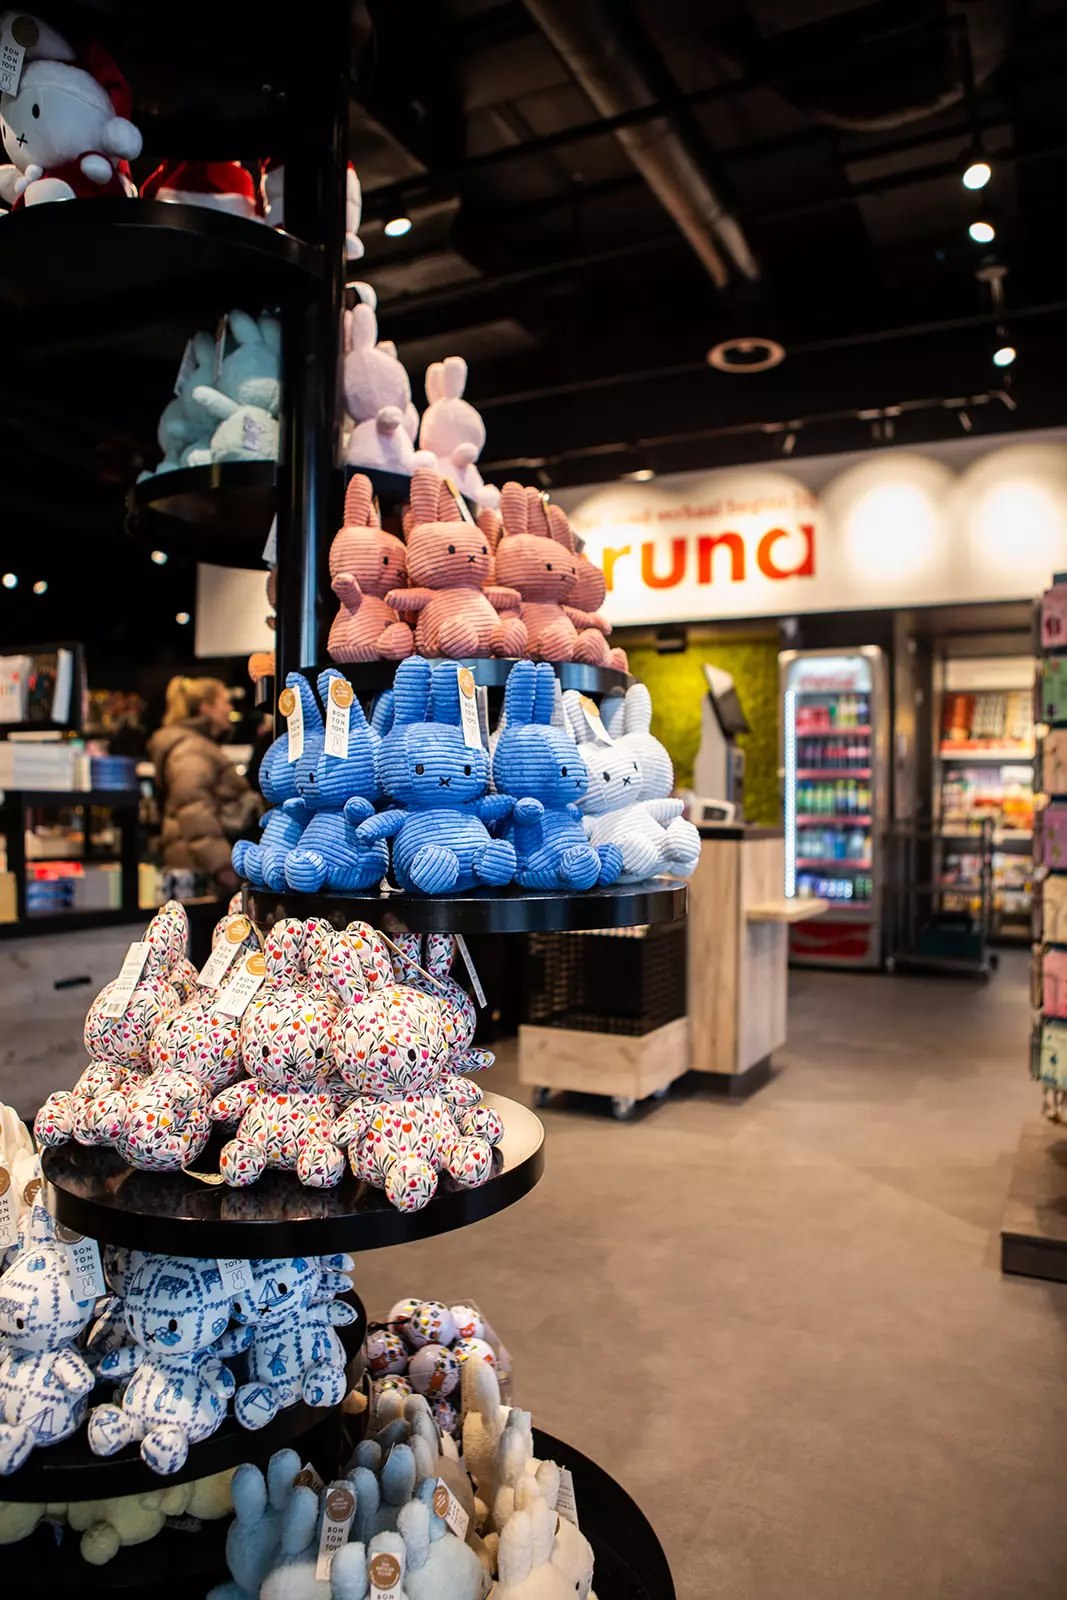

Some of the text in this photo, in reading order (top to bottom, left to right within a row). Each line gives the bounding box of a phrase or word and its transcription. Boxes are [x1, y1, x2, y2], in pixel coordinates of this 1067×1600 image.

[4, 45, 19, 56] BON
[3, 52, 18, 64] TON
[1, 60, 16, 72] TOYS
[582, 523, 817, 592] runa
[332, 709, 346, 718] BON
[332, 717, 345, 725] TON
[331, 724, 345, 734] TOYS
[239, 976, 255, 984] BON
[236, 982, 252, 990] TON
[73, 1245, 92, 1256] BON
[74, 1254, 93, 1265] TON
[76, 1263, 95, 1273] TOYS
[326, 1535, 343, 1543] TON
